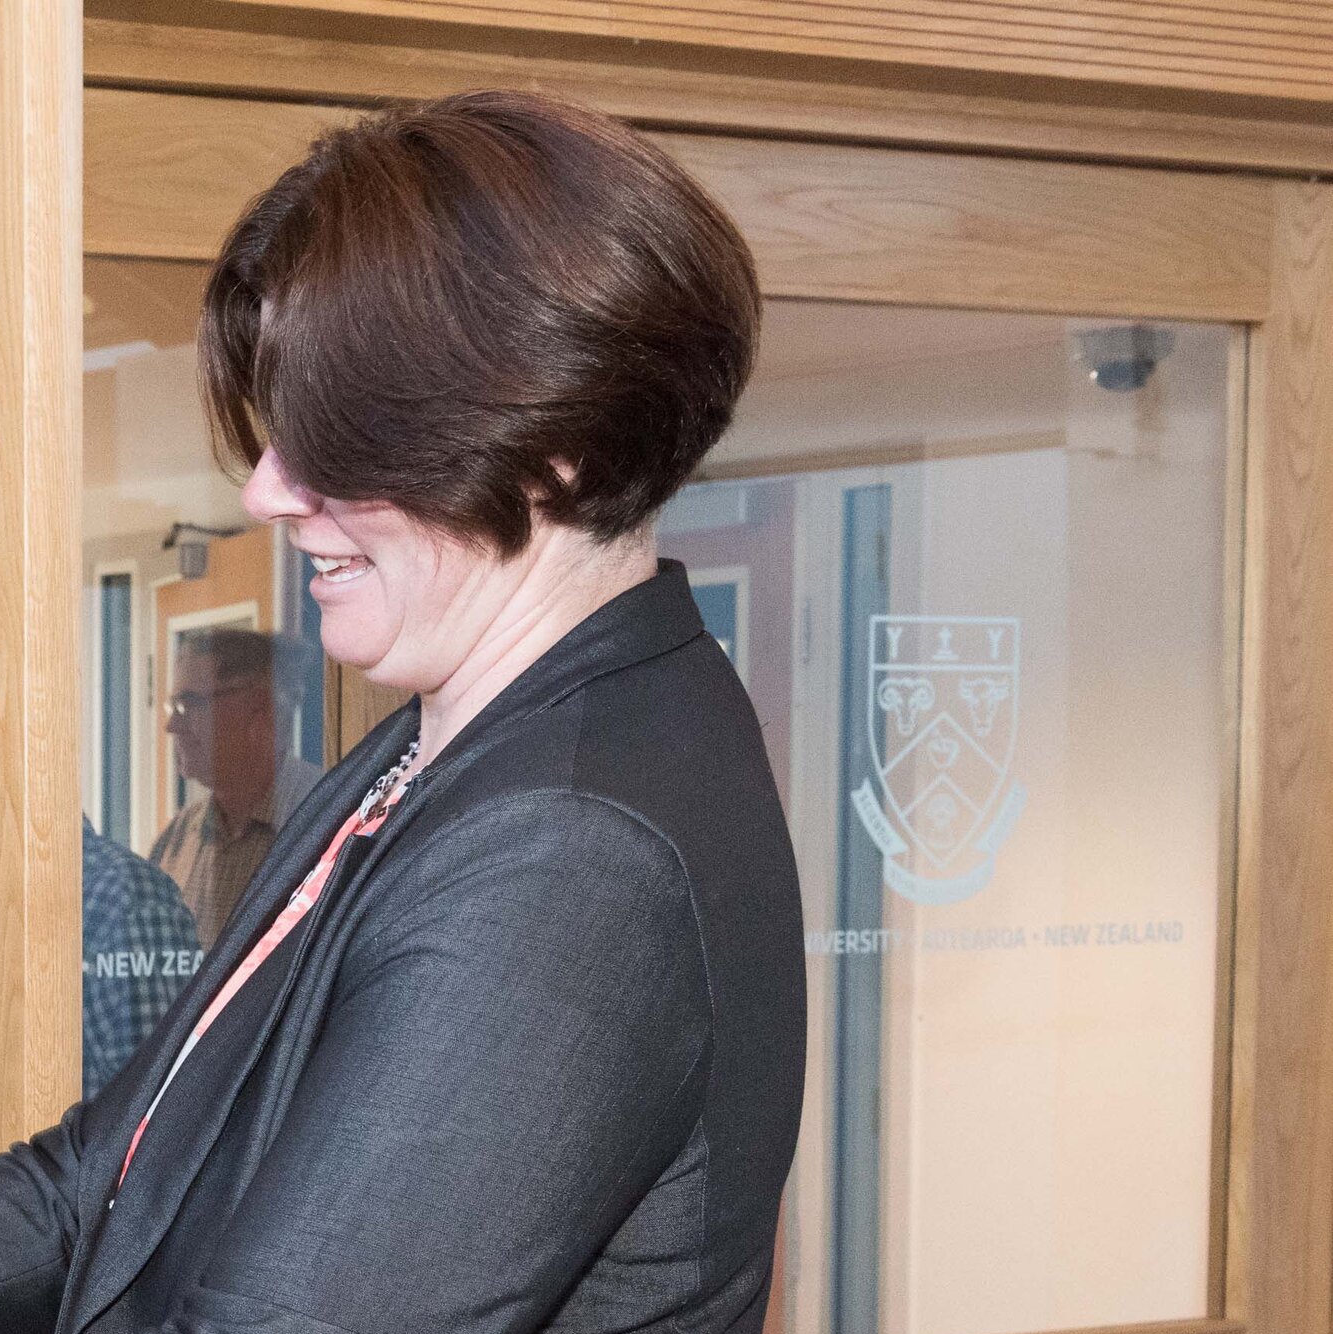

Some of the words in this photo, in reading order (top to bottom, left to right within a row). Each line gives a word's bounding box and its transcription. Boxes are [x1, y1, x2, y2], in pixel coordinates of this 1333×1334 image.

[1045, 924, 1091, 946] NEW
[1094, 920, 1184, 945] ZEALAND
[96, 951, 155, 978] NEW
